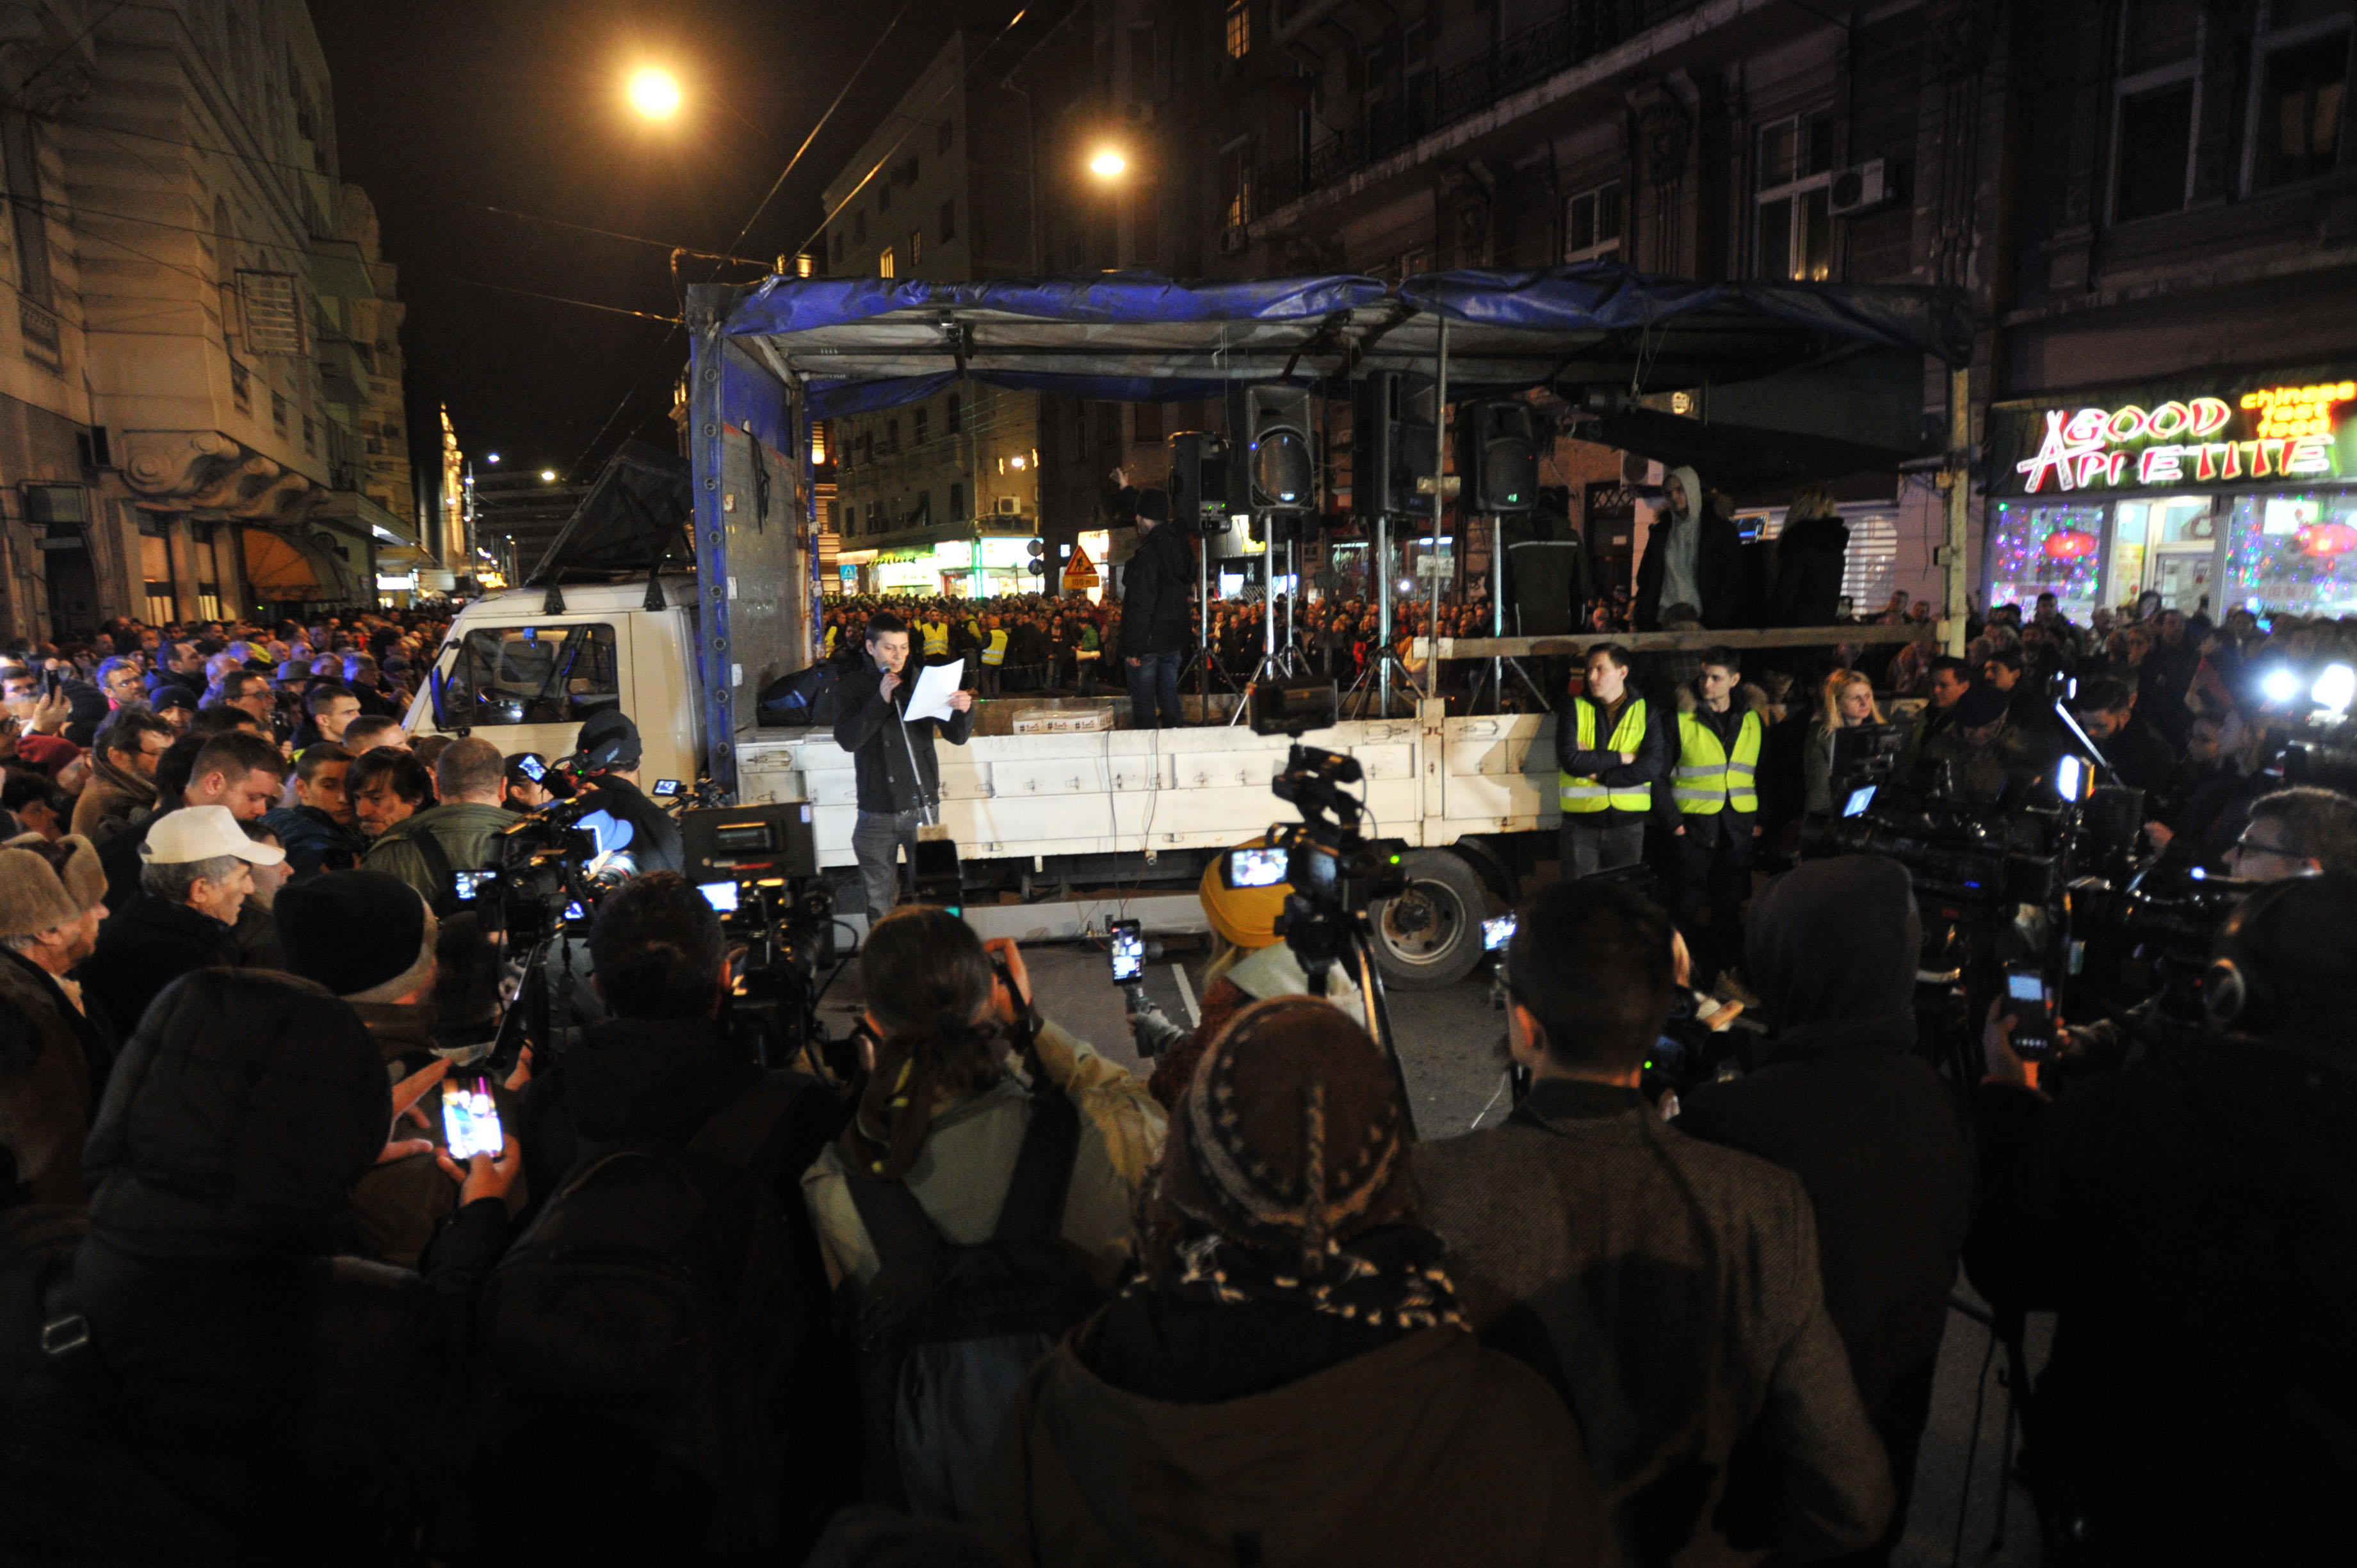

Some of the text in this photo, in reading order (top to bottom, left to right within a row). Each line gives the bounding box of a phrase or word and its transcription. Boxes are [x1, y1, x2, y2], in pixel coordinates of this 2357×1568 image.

[2062, 396, 2231, 446] GOOD
[2257, 417, 2330, 438] food
[2017, 410, 2335, 493] APPETITE
